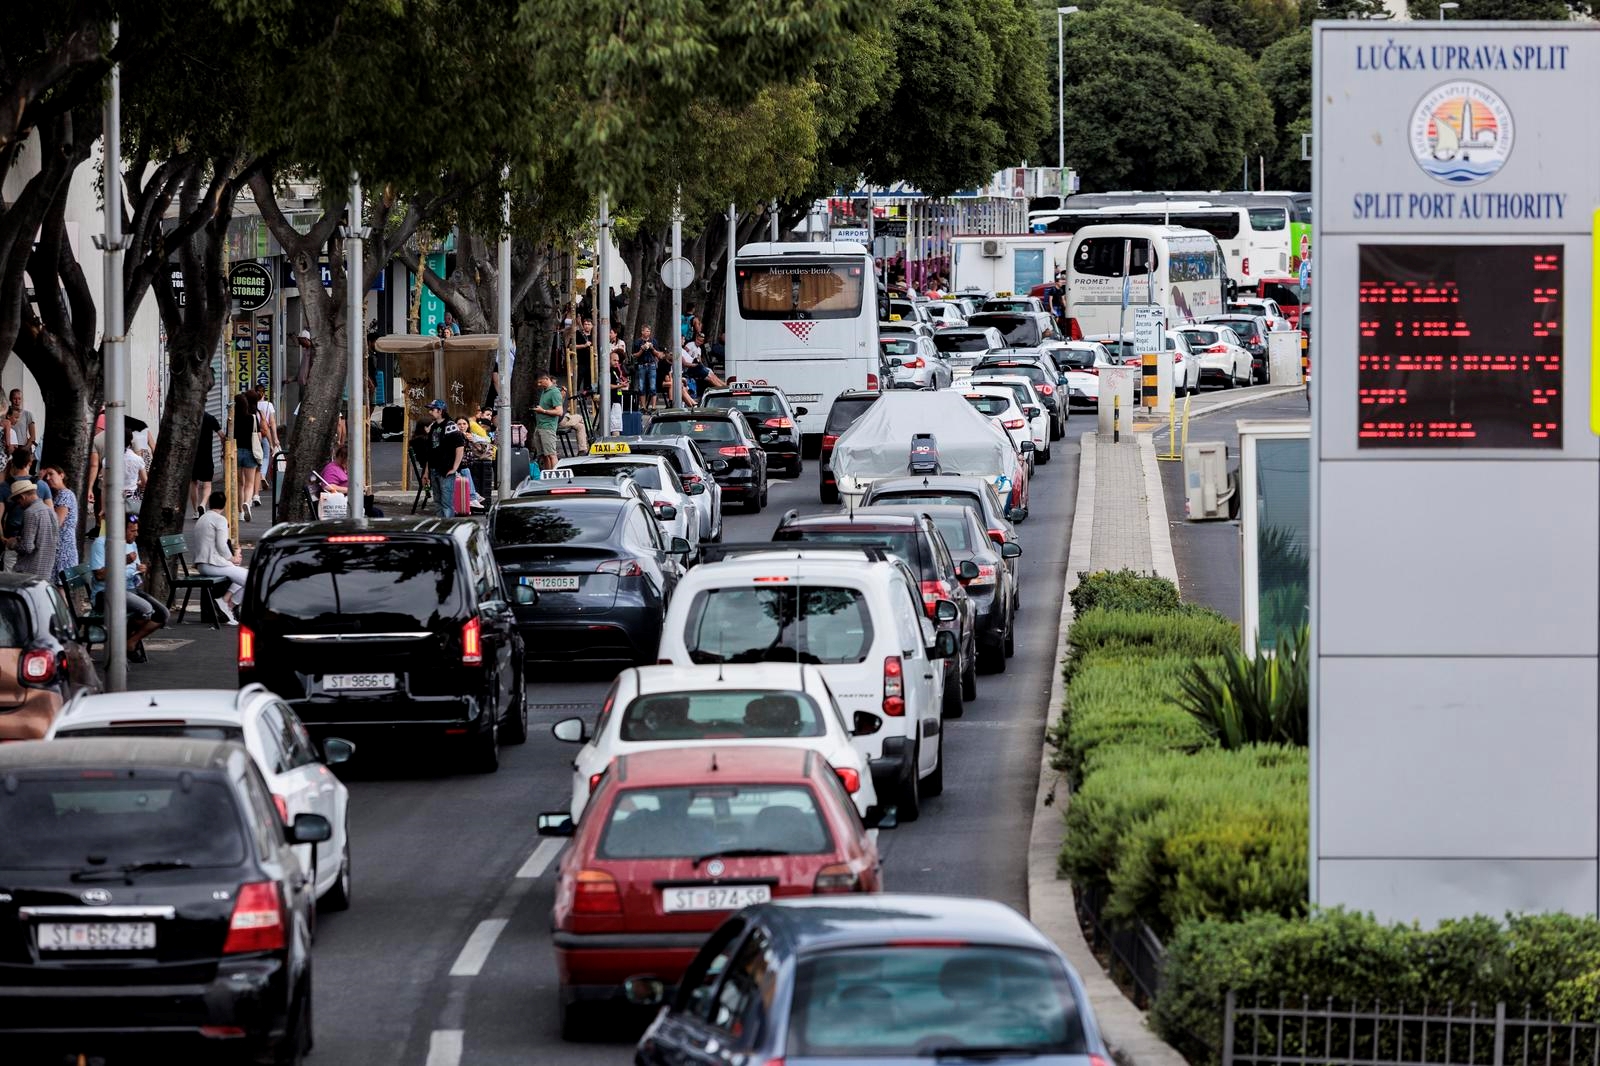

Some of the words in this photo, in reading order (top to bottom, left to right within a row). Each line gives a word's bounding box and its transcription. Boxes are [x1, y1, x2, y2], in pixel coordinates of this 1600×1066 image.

[1356, 38, 1426, 70] LUČKA
[1431, 45, 1508, 70] UPRAVA
[1512, 45, 1569, 70] SPLIT
[1353, 193, 1404, 219] SPLIT
[1408, 193, 1456, 219] PORT
[1459, 193, 1567, 219] AUTHORITY
[769, 266, 832, 275] Mercedes-Benz
[232, 276, 265, 286] LUGGAGE
[232, 286, 265, 297] STORAGE
[238, 352, 249, 392] EXCH
[594, 444, 611, 452] TAXI
[616, 443, 626, 452] 37
[545, 470, 569, 479] TAXI
[331, 676, 344, 688] ST
[676, 890, 693, 909] ST
[53, 925, 71, 945] ST
